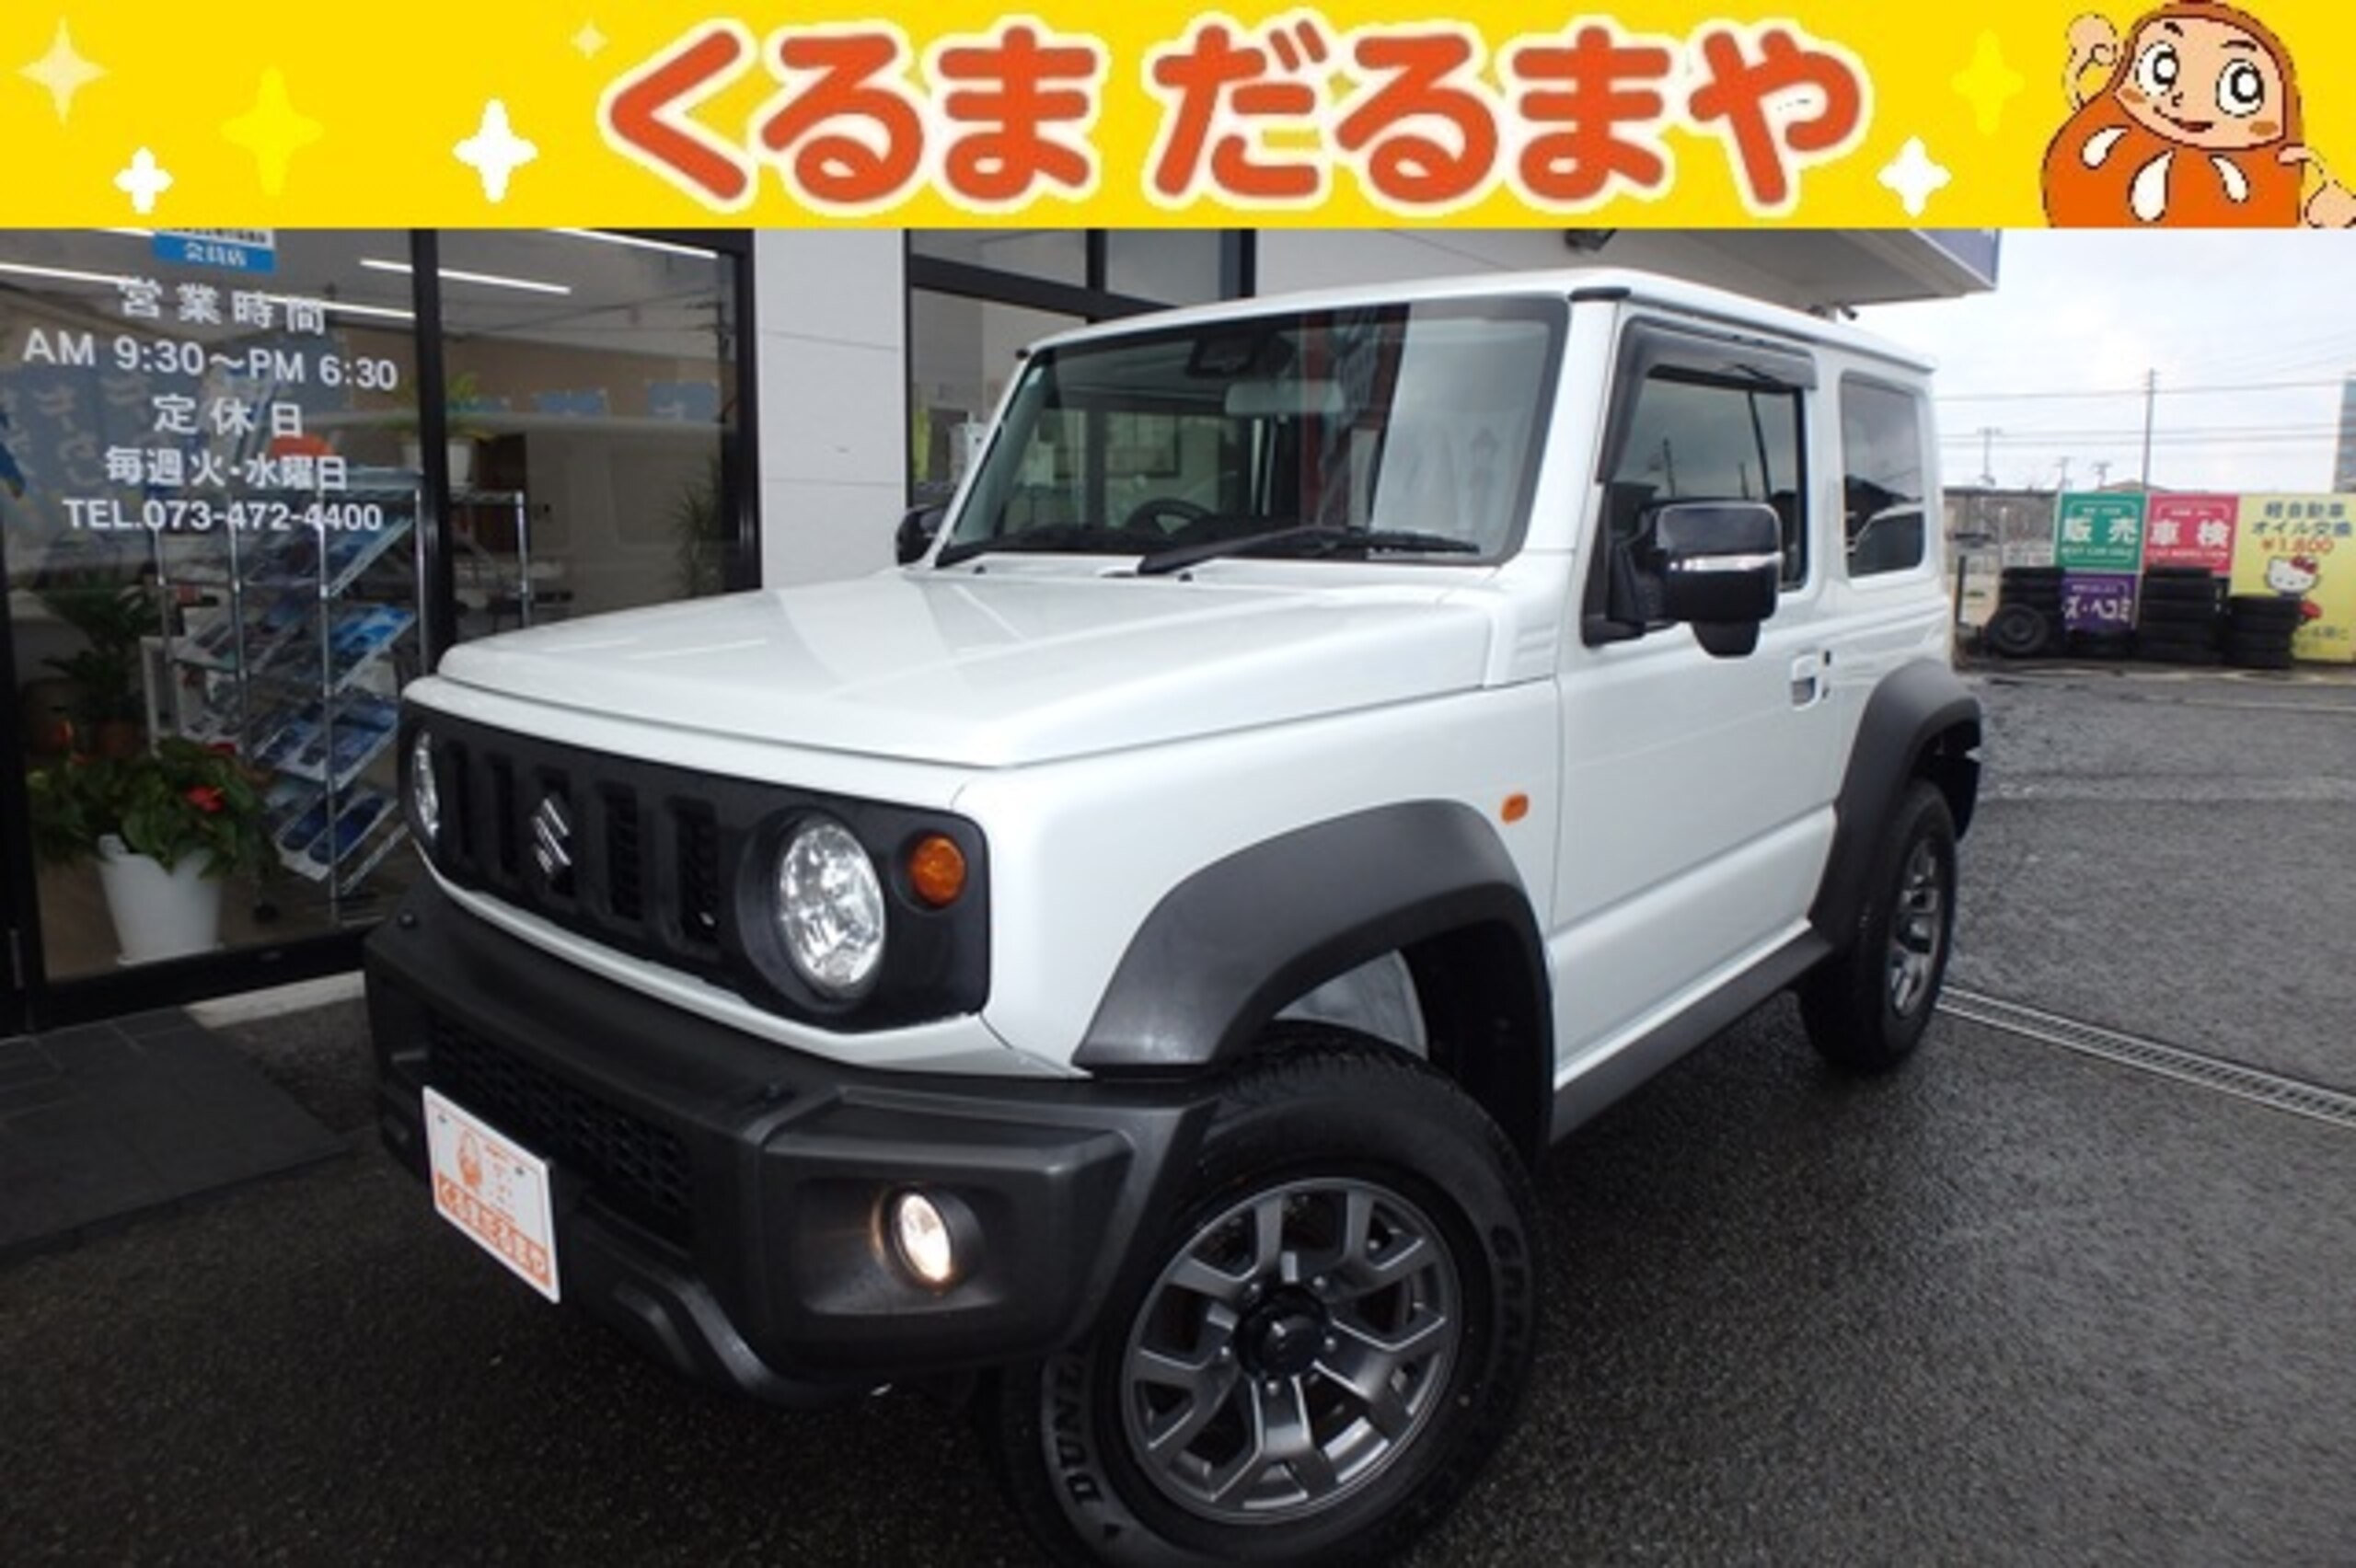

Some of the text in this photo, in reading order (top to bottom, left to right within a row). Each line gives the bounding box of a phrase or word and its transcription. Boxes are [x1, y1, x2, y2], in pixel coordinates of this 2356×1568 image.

[118, 277, 327, 337] 営業時間
[22, 329, 97, 366] AM
[319, 356, 398, 392] 6:30
[153, 393, 304, 439] 定休日
[63, 498, 383, 533] TEL.073-472-4400
[2062, 517, 2138, 545] 販売
[2150, 520, 2231, 548] 車検
